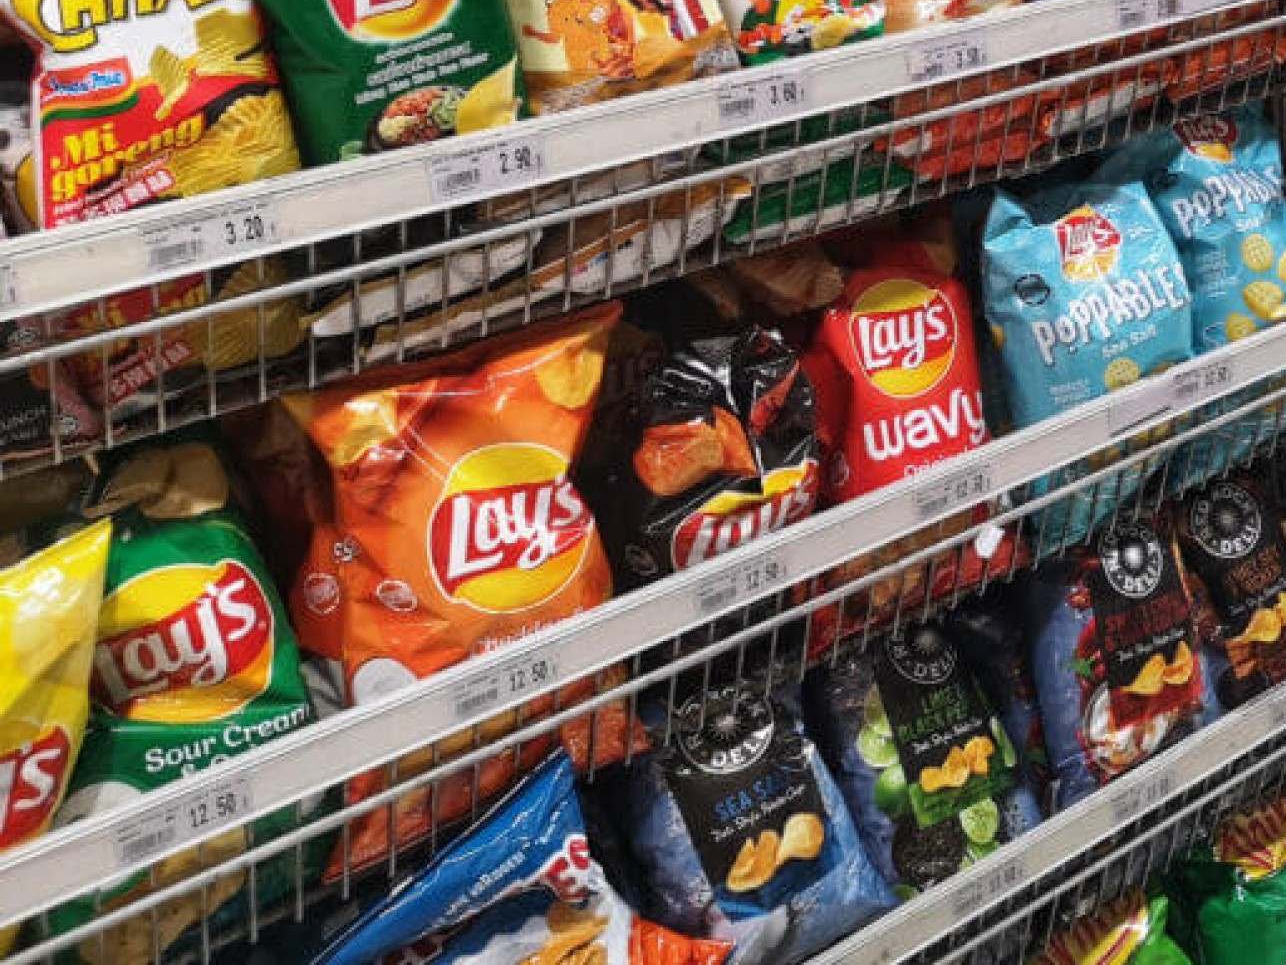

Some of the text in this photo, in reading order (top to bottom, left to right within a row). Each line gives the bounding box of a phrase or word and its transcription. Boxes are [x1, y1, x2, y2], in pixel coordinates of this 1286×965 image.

[857, 298, 948, 369] Lay's
[863, 387, 984, 461] wavy
[447, 474, 583, 579] Lay's
[98, 578, 257, 705] Lay's
[144, 705, 310, 774] Sour Cream
[188, 792, 237, 829] 12.50
